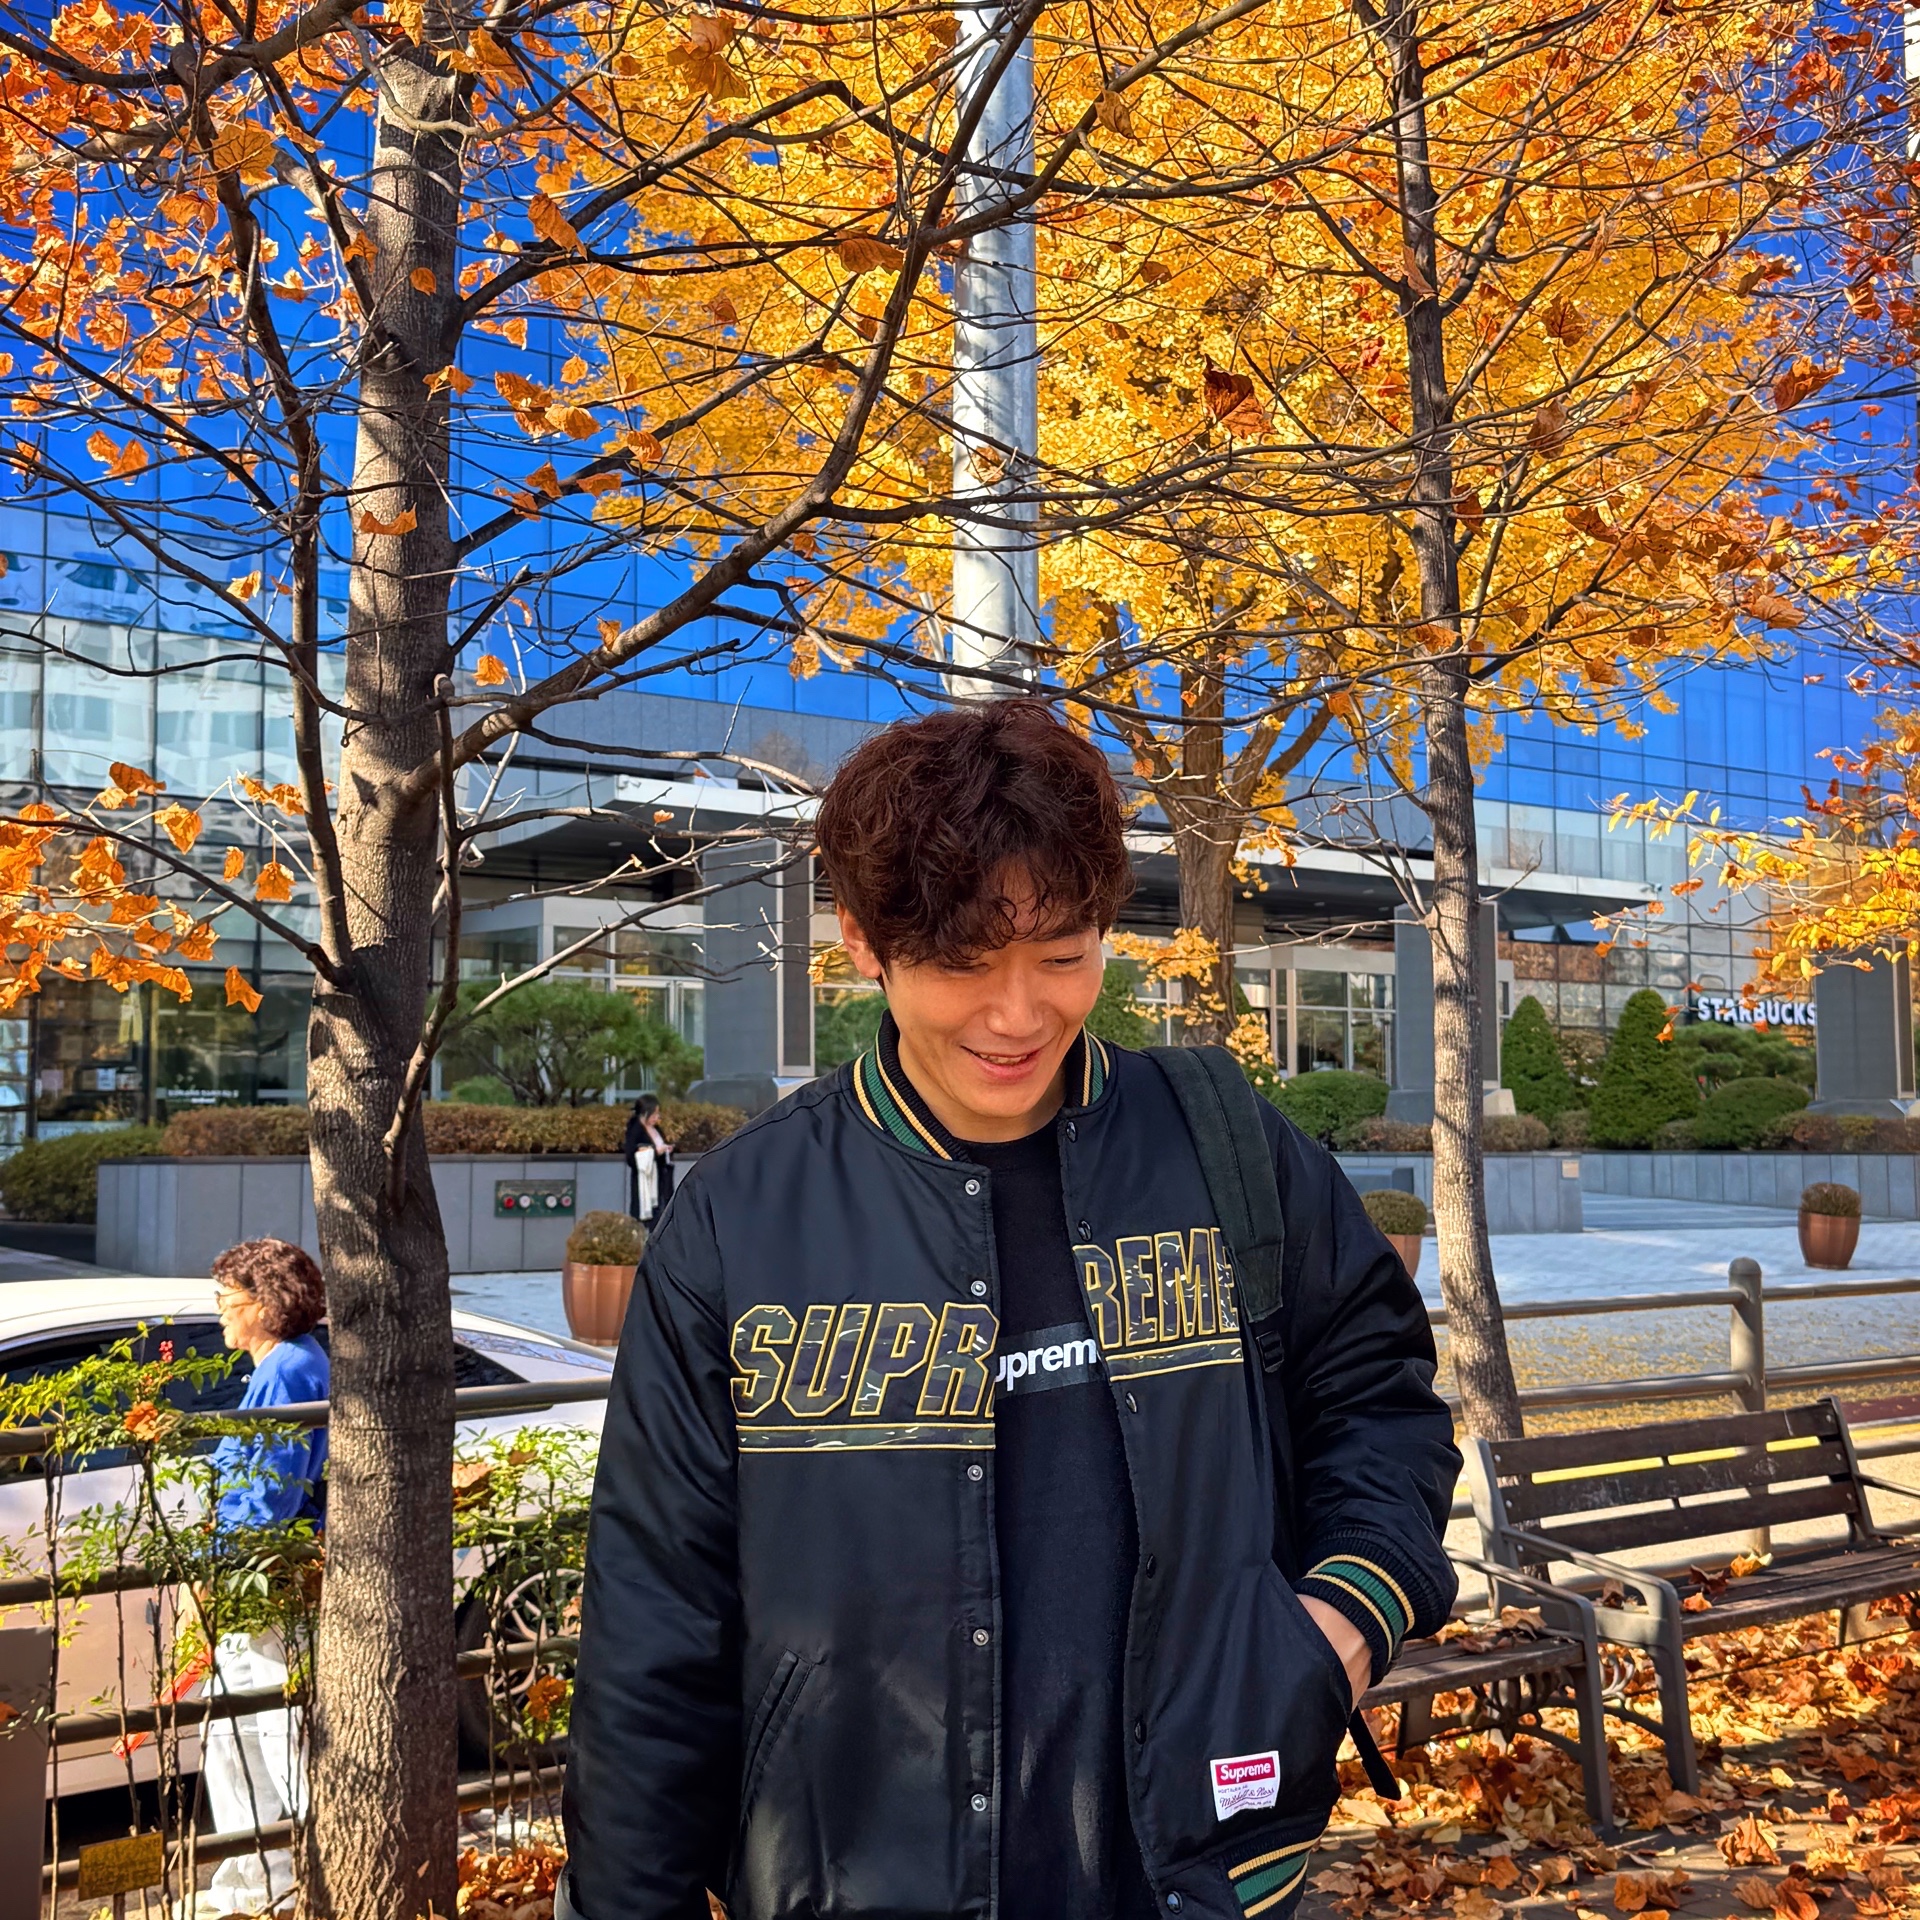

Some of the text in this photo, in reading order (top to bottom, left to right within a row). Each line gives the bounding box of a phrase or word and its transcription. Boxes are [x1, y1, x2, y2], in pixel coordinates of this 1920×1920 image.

[1697, 997, 1817, 1026] STARBUCKS
[730, 1302, 1000, 1418] SUPR
[994, 1339, 1101, 1392] uprem
[1220, 1762, 1271, 1783] Supreme
